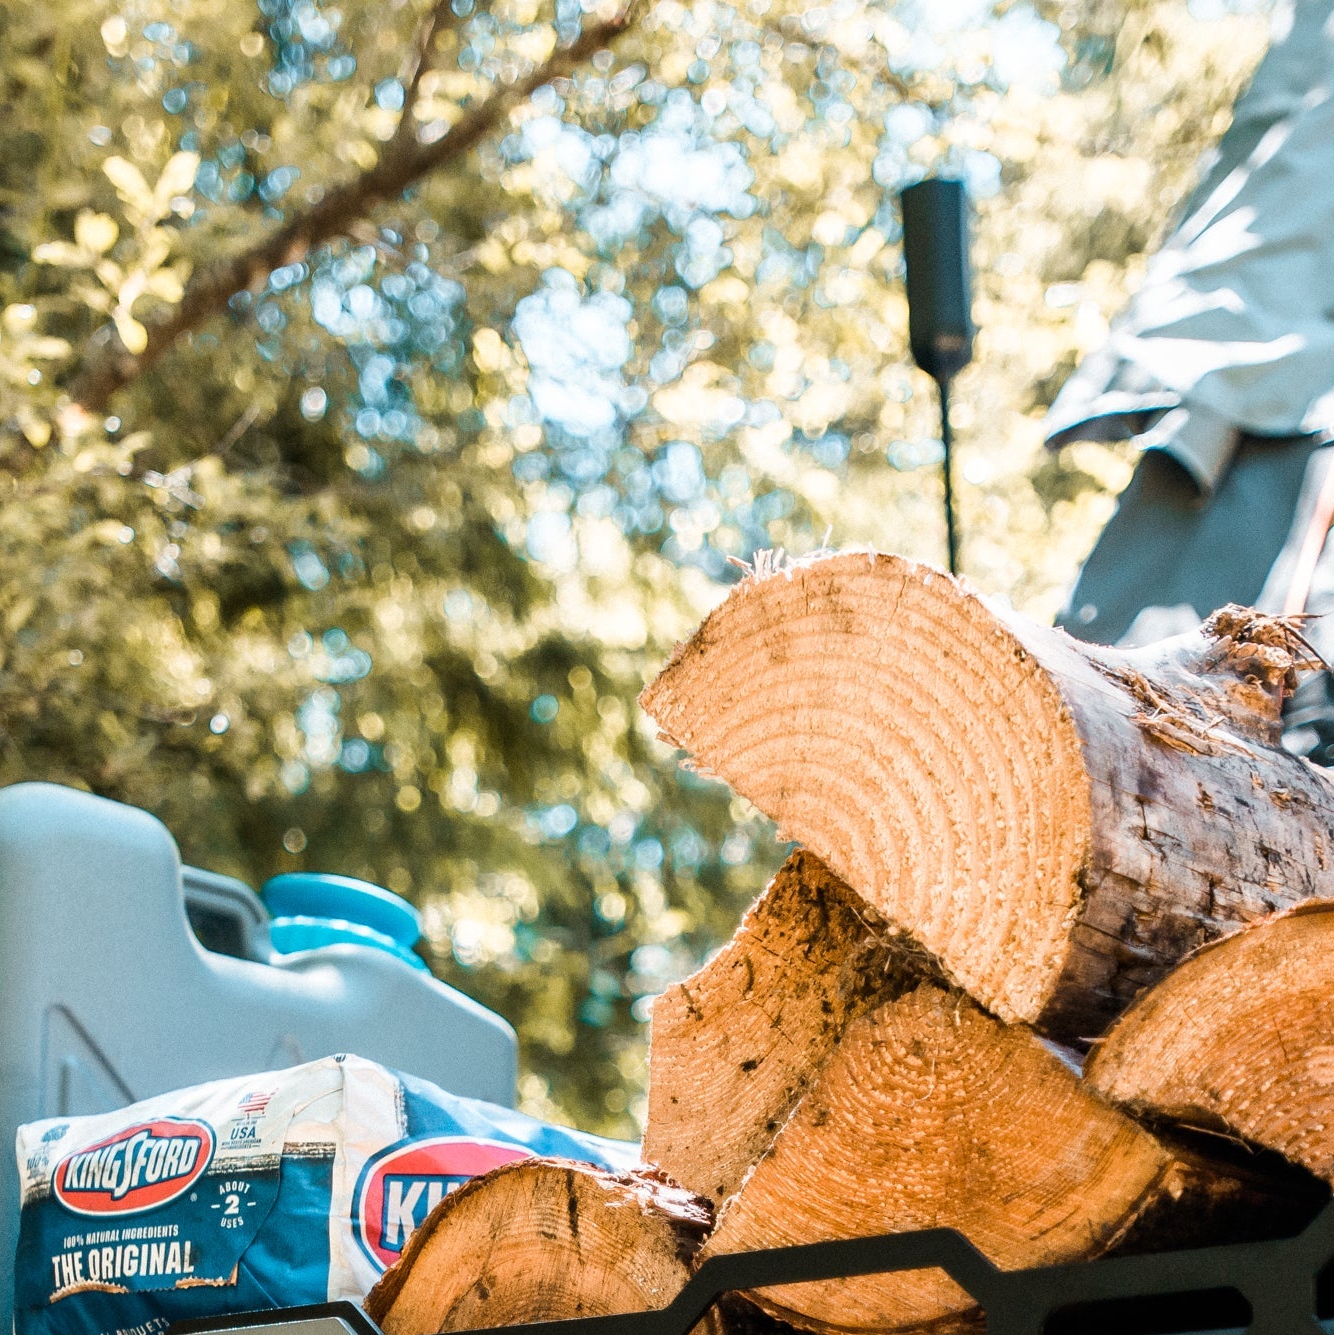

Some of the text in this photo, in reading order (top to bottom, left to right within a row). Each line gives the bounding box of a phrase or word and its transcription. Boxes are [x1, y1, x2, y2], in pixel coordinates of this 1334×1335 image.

[230, 1126, 256, 1140] USA
[64, 1130, 201, 1196] KINGSFORD
[219, 1181, 251, 1195] ABOUT
[224, 1194, 240, 1215] 2
[220, 1216, 244, 1229] USES
[63, 1224, 179, 1249] 100% NATURAL INGREDIENTS
[51, 1240, 195, 1288] THE ORIGINAL
